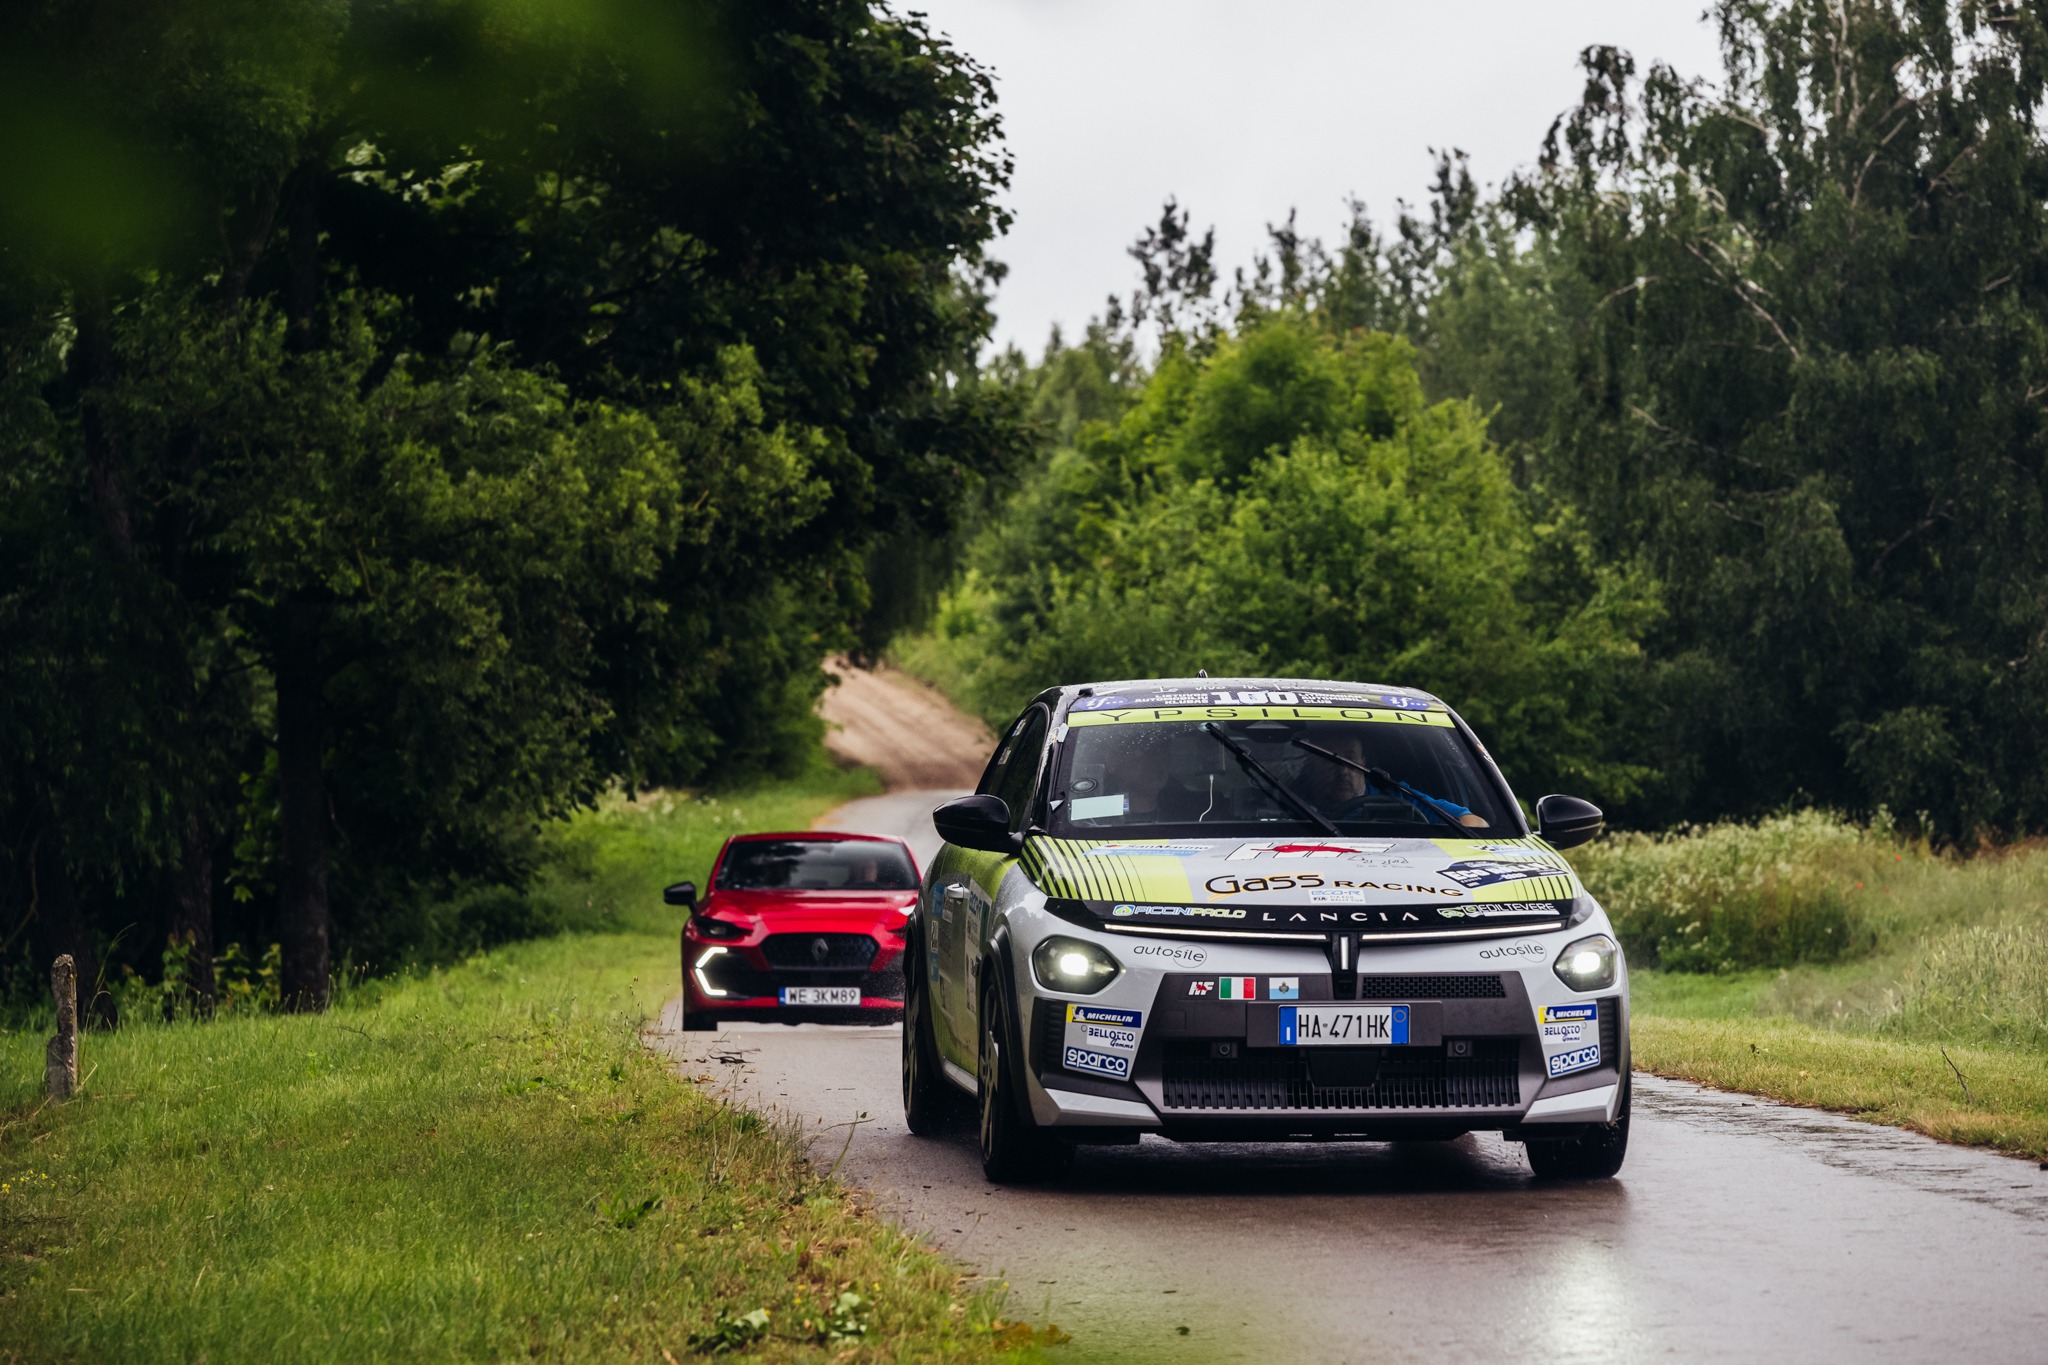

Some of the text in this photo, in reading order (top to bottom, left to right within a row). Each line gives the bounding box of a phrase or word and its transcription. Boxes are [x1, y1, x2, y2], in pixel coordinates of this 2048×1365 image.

[1210, 690, 1299, 705] 100
[1100, 707, 1429, 723] YPSILON
[1333, 880, 1464, 897] RACING
[1262, 911, 1420, 922] LANCIA
[1133, 945, 1204, 962] autosile
[1479, 943, 1544, 960] autosile
[788, 988, 857, 1004] WE 3KM89
[1087, 1012, 1134, 1023] MICHELIN
[1556, 1009, 1593, 1018] MICHELIN
[1088, 1027, 1134, 1042] BELLOTTO
[1544, 1025, 1581, 1036] BELLOTTO
[1067, 1048, 1127, 1072] sparco
[1551, 1046, 1598, 1073] sparco
